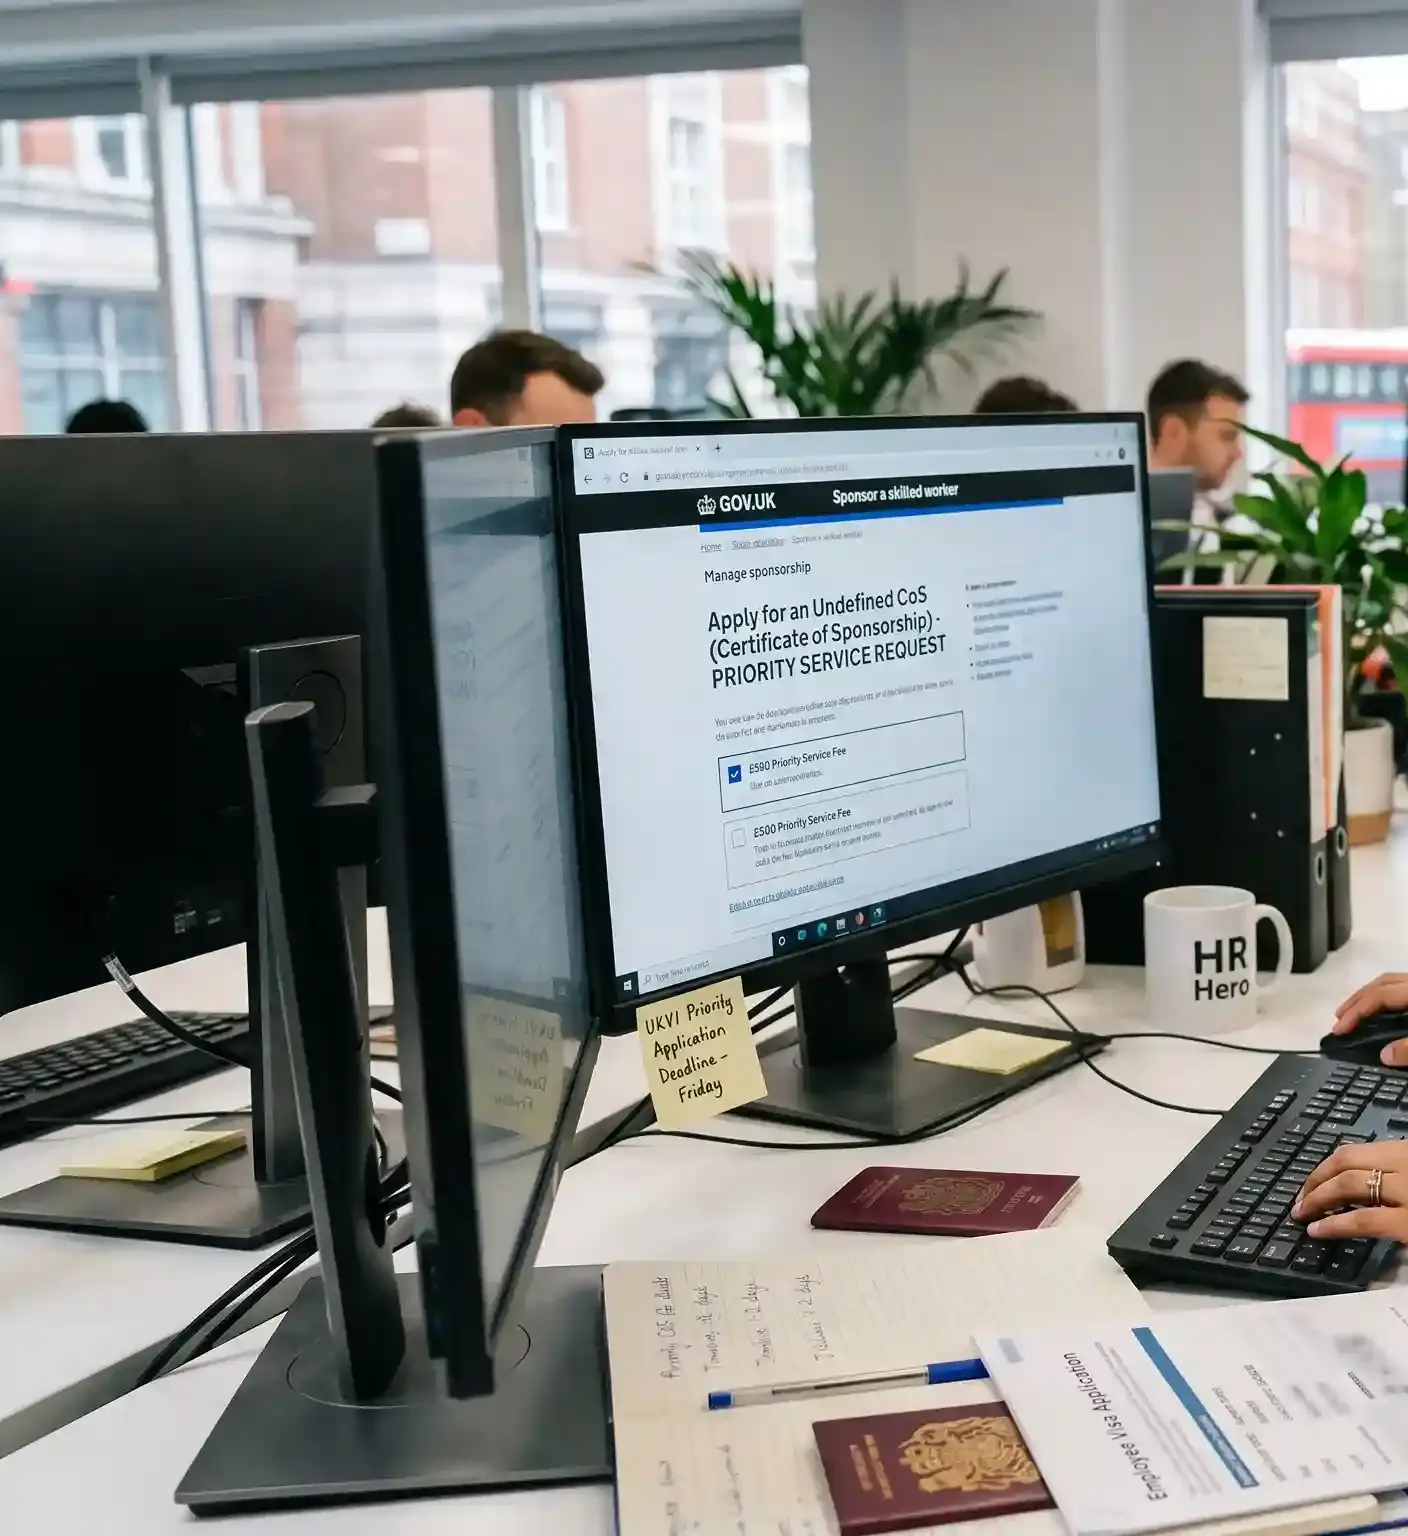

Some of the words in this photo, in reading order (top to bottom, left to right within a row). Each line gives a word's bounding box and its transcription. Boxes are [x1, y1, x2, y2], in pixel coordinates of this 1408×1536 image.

[719, 492, 776, 512] GOV.UK
[832, 489, 878, 507] Sponsor
[879, 490, 887, 500] a
[888, 486, 922, 501] skilled
[924, 484, 959, 498] worker
[705, 569, 747, 584] Manage
[749, 561, 811, 580] sponsorship
[708, 607, 758, 634] Apply
[762, 604, 787, 624] for
[790, 604, 809, 620] an
[813, 590, 893, 617] Undefined
[897, 585, 927, 606] CoS
[710, 629, 808, 664] (Certificate
[812, 624, 828, 644] of
[831, 610, 932, 644] Sponsorship)
[712, 657, 796, 689] PRIORITY
[800, 646, 871, 675] SERVICE
[875, 634, 946, 662] REQUEST
[772, 755, 801, 769] Priority
[802, 750, 831, 763] Service
[832, 747, 847, 756] Fee
[777, 818, 807, 832] Priority
[808, 811, 836, 825] Service
[837, 808, 851, 817] Fee
[1194, 936, 1247, 974] HR
[1195, 979, 1249, 1001] Hero
[645, 1010, 679, 1035] UKVI
[686, 993, 734, 1021] Priority
[654, 1026, 726, 1060] Application
[658, 1055, 717, 1084] Deadline
[678, 1078, 723, 1103] Friday
[1064, 1352, 1112, 1412] Application
[1120, 1442, 1168, 1501] Employee
